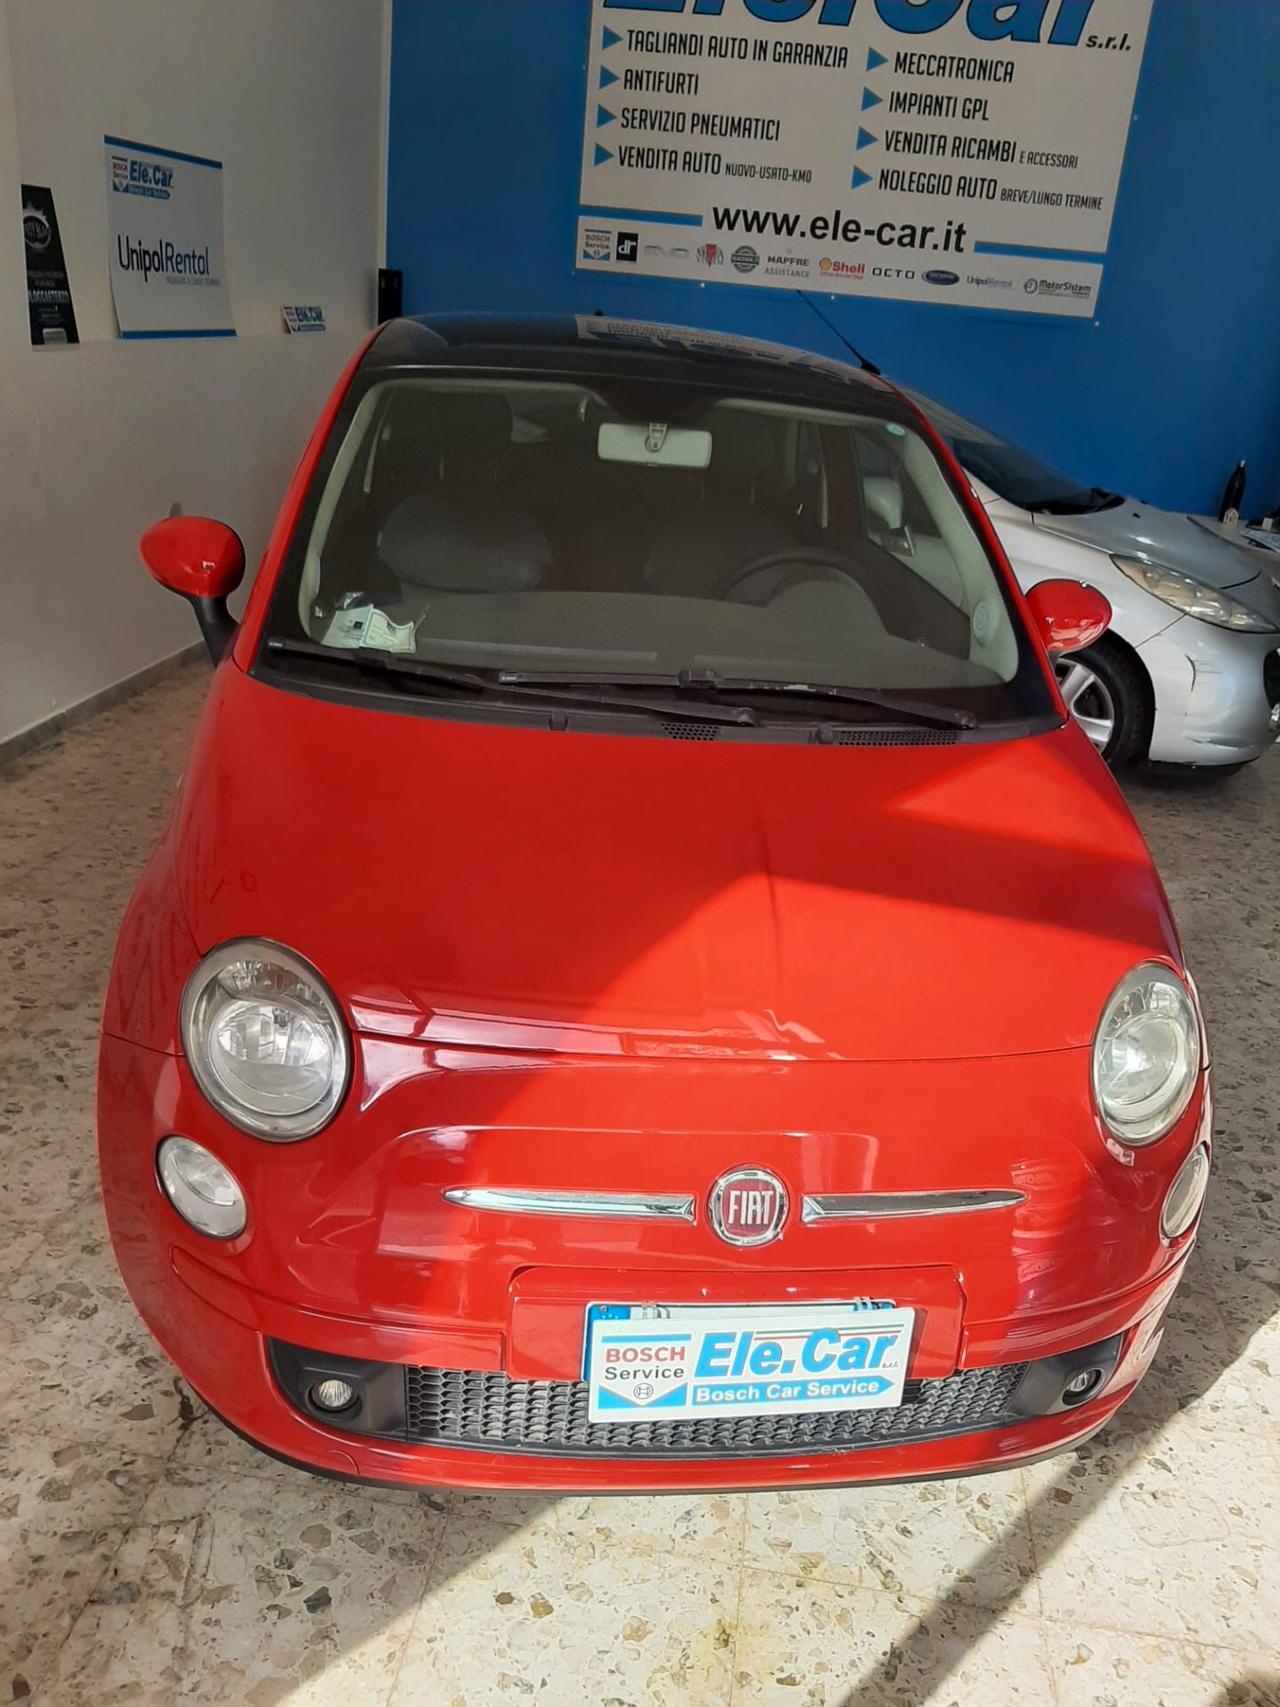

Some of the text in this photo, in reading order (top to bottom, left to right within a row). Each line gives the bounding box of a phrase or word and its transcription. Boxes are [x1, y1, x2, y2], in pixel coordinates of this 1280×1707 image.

[627, 30, 848, 68] TAGLIANDI AUTO IN GARANZIA
[1086, 33, 1131, 51] s.r.l.
[894, 51, 1015, 83] MECCATRONICA
[624, 69, 699, 95] ANTIFURTI
[889, 91, 989, 121] IMPIANTI GPL
[621, 108, 780, 141] SERVIZIO PNEUMATICI
[618, 145, 678, 171] VENDITA
[682, 150, 721, 175] AUTO
[885, 130, 1078, 169] VENDITA RICAMBI E ACCESSORI
[129, 160, 174, 187] Ele.Car
[878, 169, 1104, 210] NOLEGGIO AUTO BREVE/LUNGO TERMINE
[712, 207, 967, 253] www.ele-car.it
[117, 234, 210, 283] UnipolRental
[767, 254, 810, 267] MAPFRE
[831, 260, 865, 274] Shell
[764, 267, 811, 279] ASSISTANCE
[872, 266, 915, 280] OCTO
[1038, 279, 1092, 293] MotorSistem
[728, 1190, 774, 1225] FIAT
[605, 1346, 686, 1363] BOSCH
[694, 1327, 898, 1378] Ele.Car
[604, 1365, 685, 1381] Service
[696, 1379, 880, 1403] Bosch Car Service
